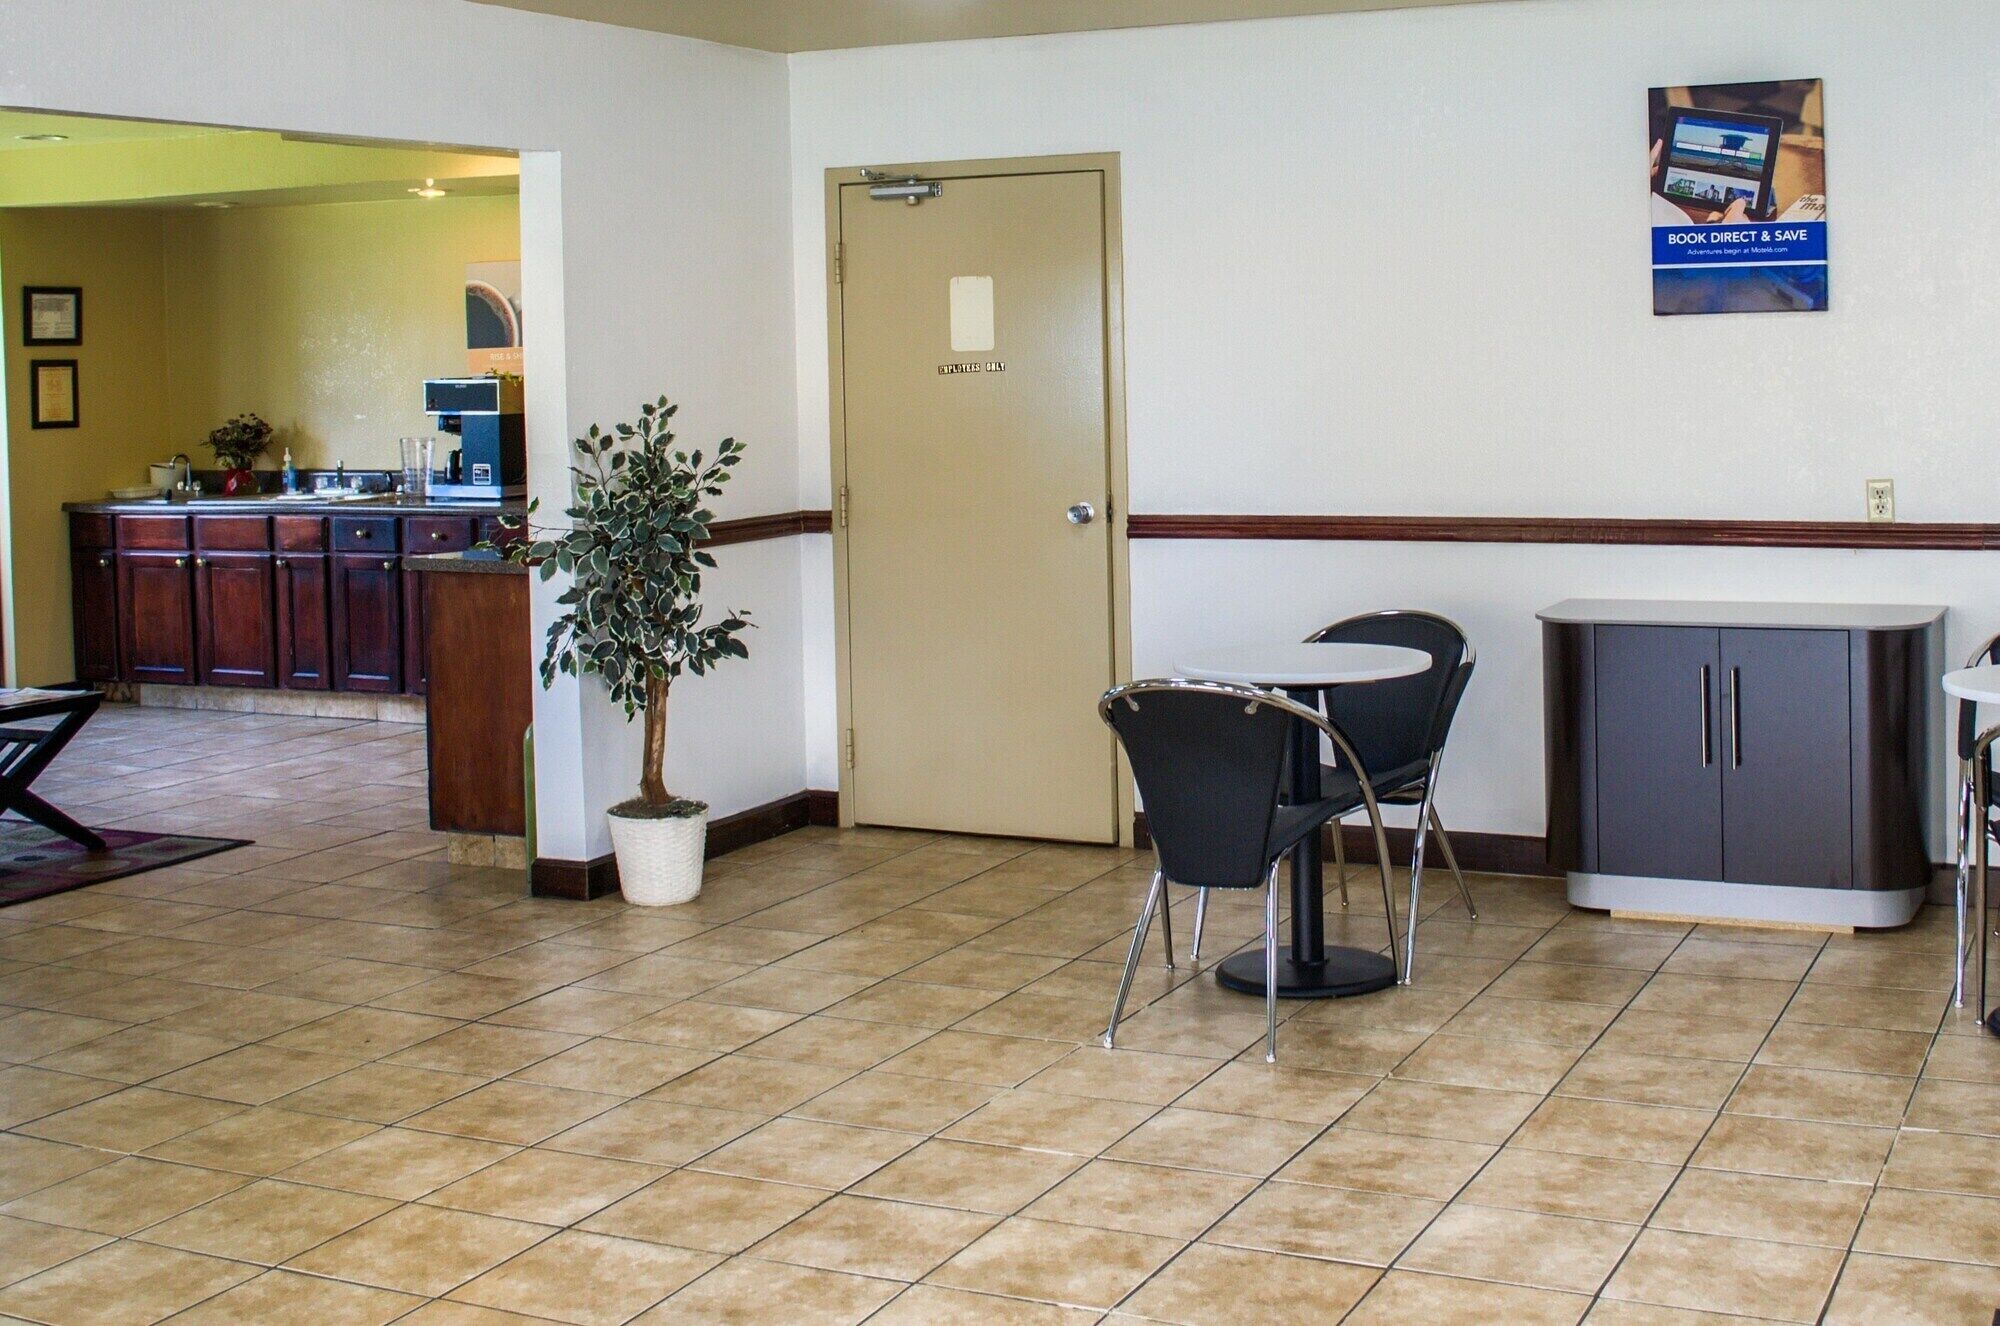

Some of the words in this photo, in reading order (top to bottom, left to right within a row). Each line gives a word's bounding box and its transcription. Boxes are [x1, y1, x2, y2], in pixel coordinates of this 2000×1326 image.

[1668, 233, 1707, 245] BOOK
[1710, 231, 1757, 243] DIRECT
[1760, 230, 1771, 242] &
[1774, 229, 1808, 241] SAVE
[1687, 248, 1723, 256] Adventures
[1723, 247, 1742, 256] begin
[986, 362, 1005, 372] ONLY
